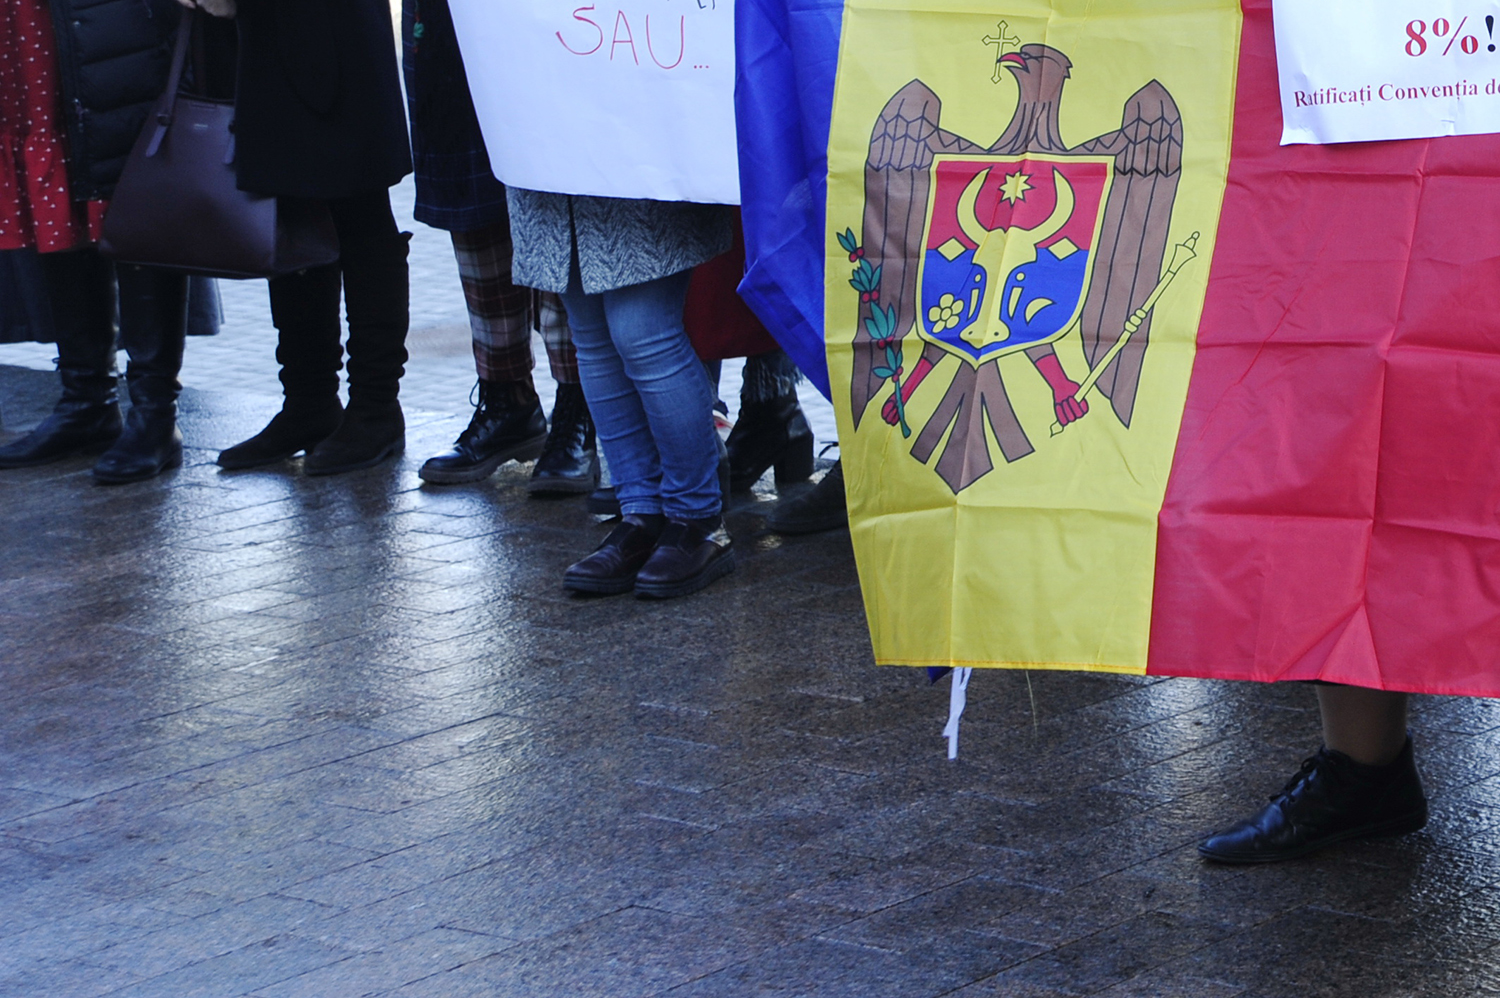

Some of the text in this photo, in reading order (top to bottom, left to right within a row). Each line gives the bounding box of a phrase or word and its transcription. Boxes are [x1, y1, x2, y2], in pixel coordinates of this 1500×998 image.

[555, 4, 710, 70] SAU...
[1405, 15, 1497, 57] 8%!
[1294, 85, 1371, 108] Ratificați
[1378, 79, 1478, 101] Convenția
